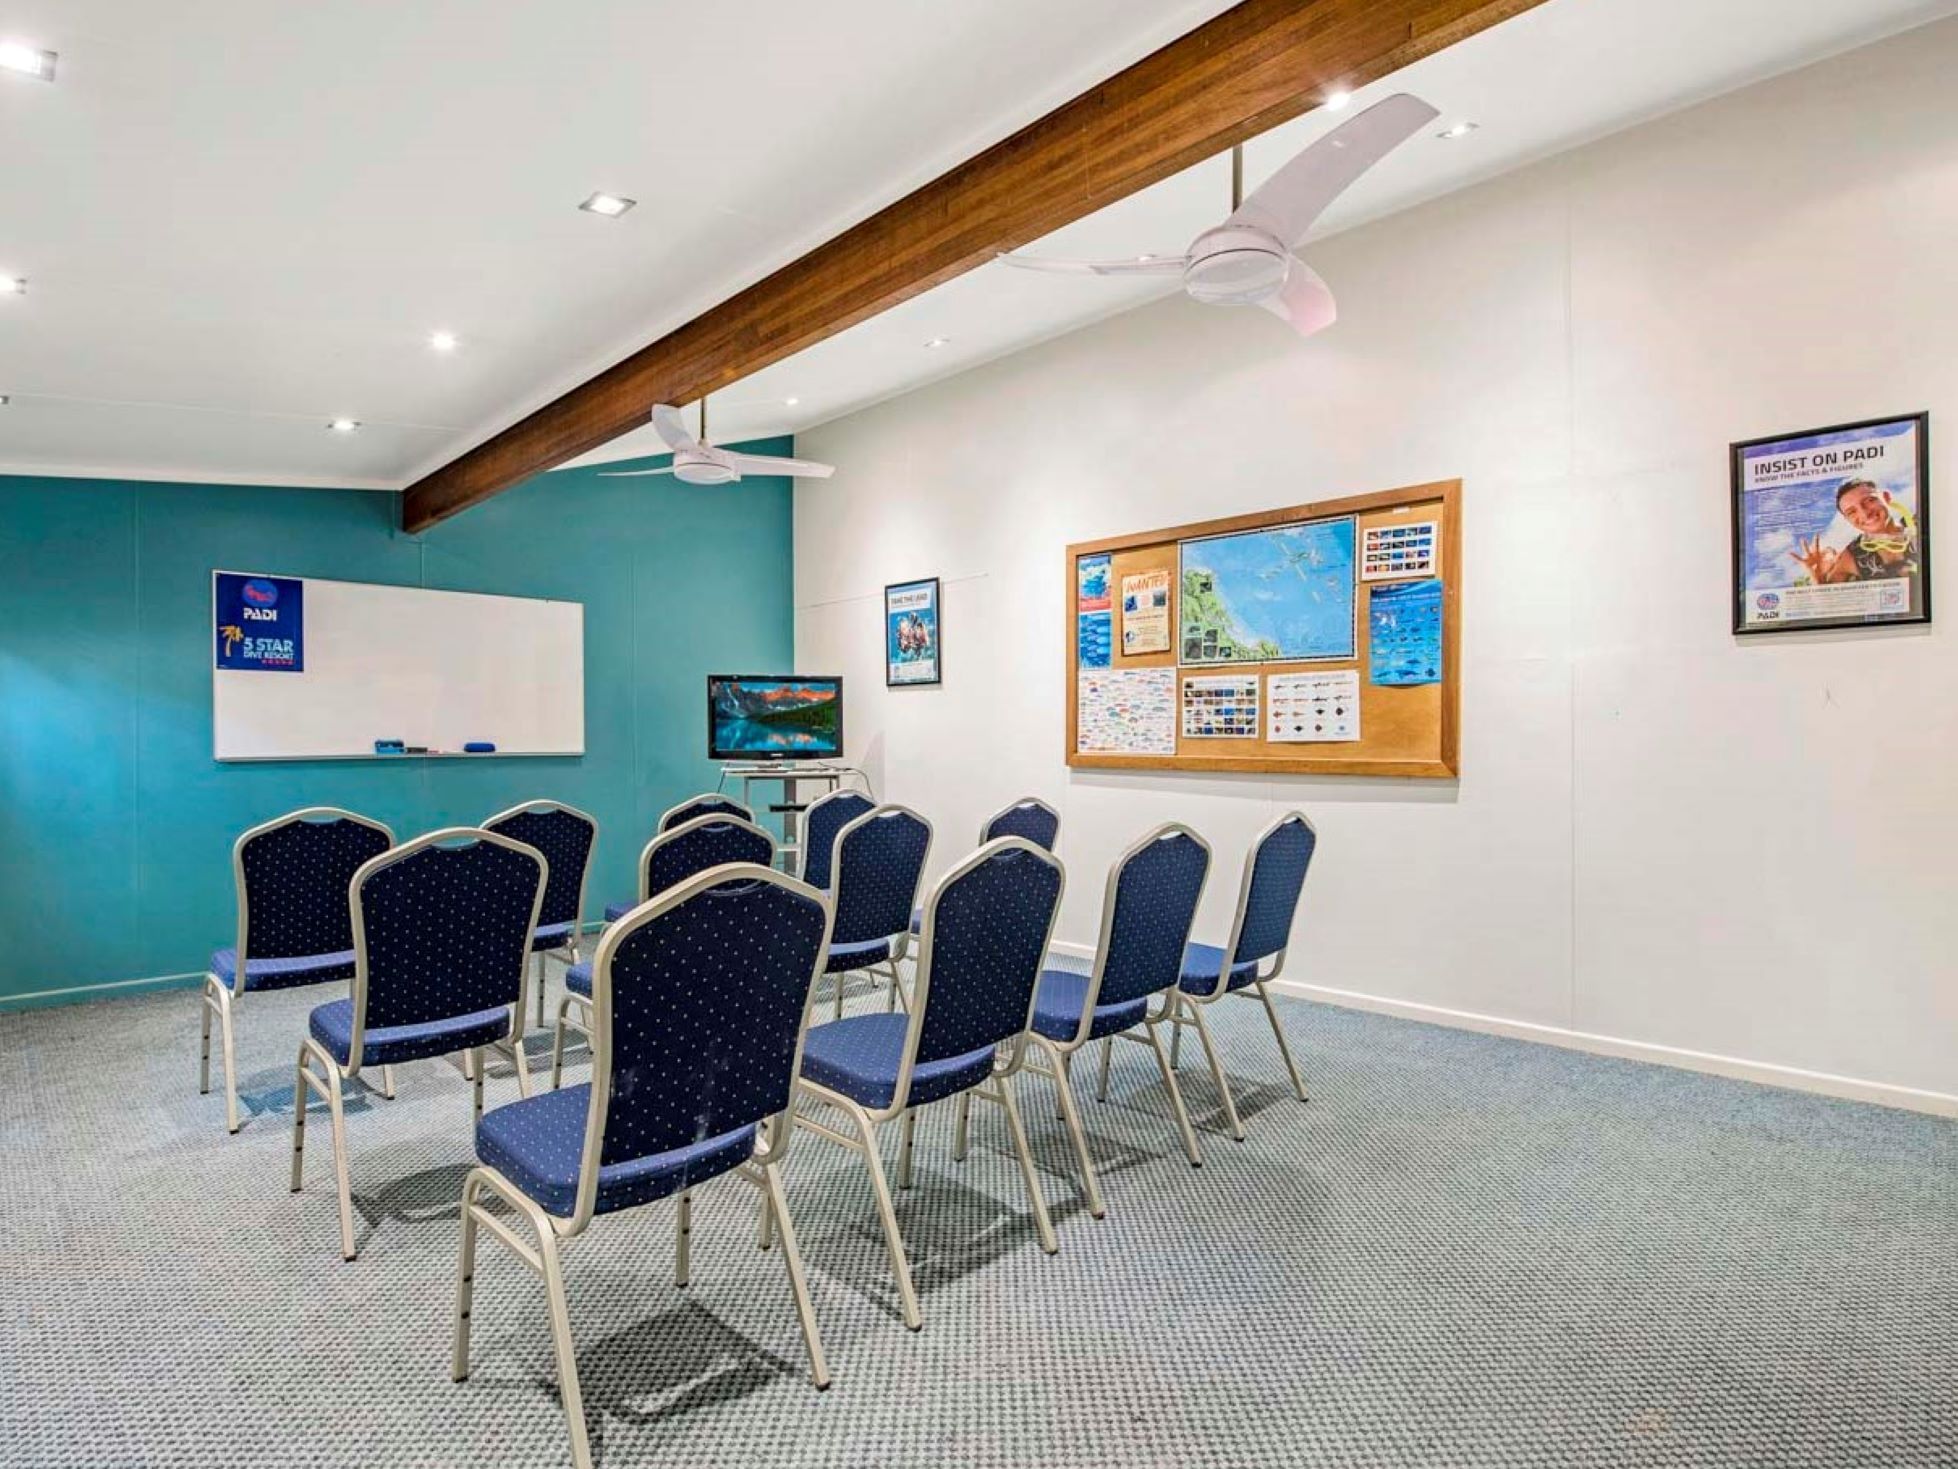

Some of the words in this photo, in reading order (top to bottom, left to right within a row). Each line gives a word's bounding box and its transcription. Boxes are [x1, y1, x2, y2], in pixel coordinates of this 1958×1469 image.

[1754, 457, 1807, 476] INSIST
[1812, 452, 1837, 467] ON
[1843, 445, 1884, 463] PADI
[1755, 474, 1779, 483] KNOW
[1780, 472, 1795, 480] THE
[1796, 468, 1820, 477] FACTS
[1829, 463, 1863, 473] FIGURES
[243, 607, 277, 621] PADI
[1756, 610, 1779, 620] PADI
[243, 637, 254, 651] 5
[256, 638, 294, 653] STAR
[243, 650, 262, 659] DIVE
